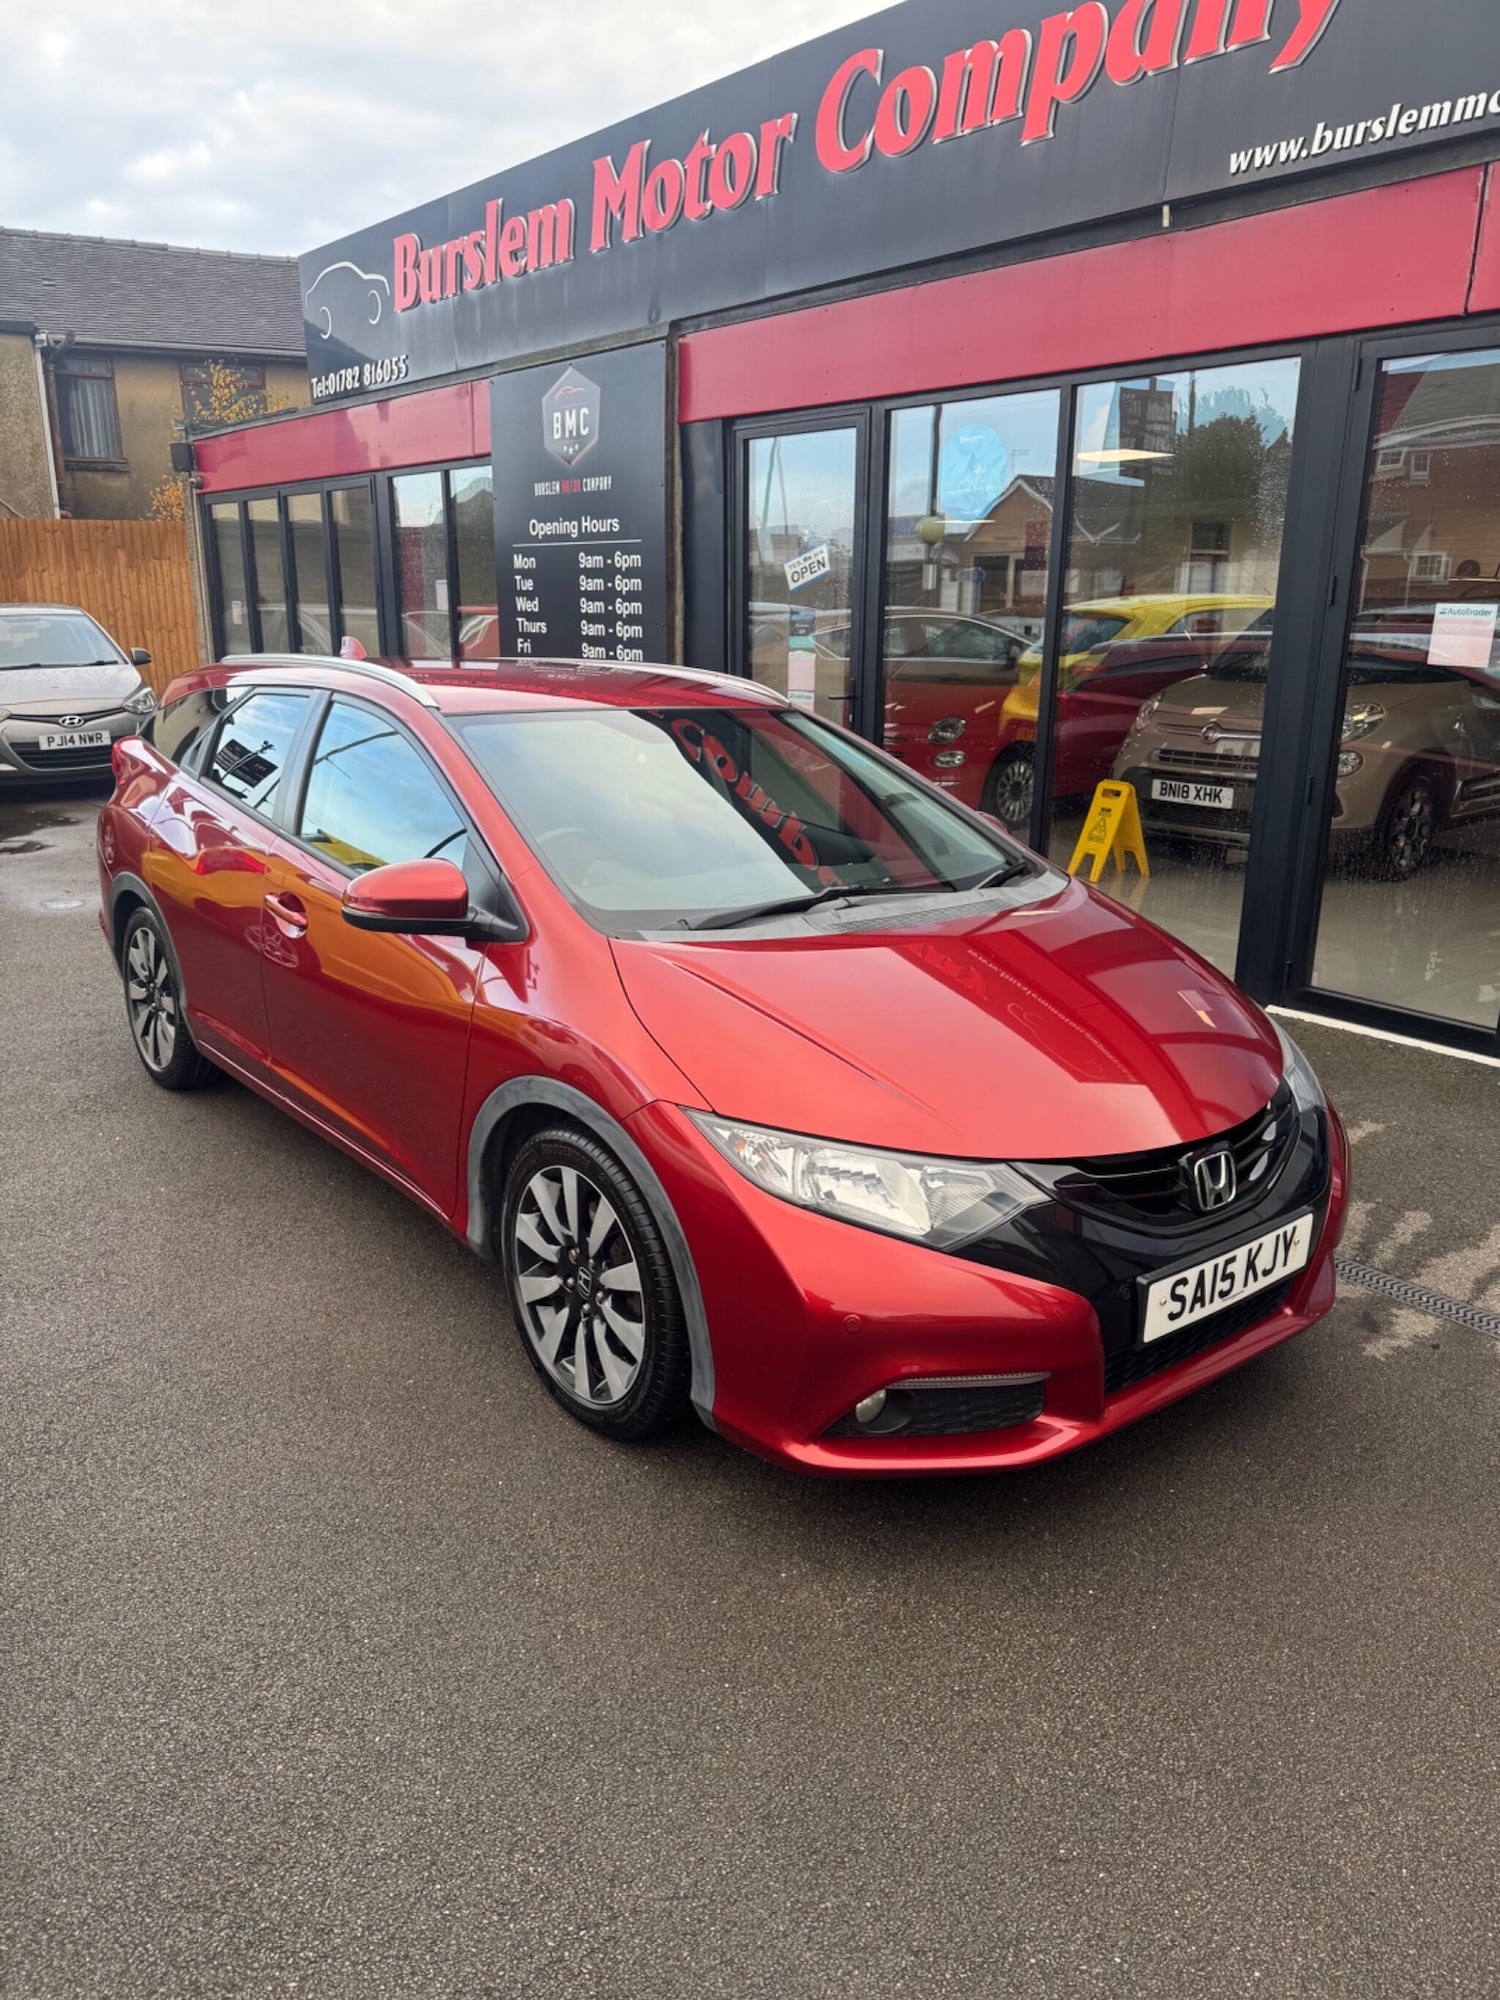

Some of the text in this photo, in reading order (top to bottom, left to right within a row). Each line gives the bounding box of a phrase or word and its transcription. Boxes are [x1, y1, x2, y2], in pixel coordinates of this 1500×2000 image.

[392, 197, 575, 313] Burslem
[589, 112, 798, 254] Motor
[310, 354, 408, 399] Tel:01782 816055
[553, 406, 589, 440] BMC
[529, 515, 620, 540] Opening Hours
[513, 553, 536, 570] Mon
[578, 552, 604, 569] 9am
[614, 551, 642, 572] 6pm
[791, 556, 826, 583] OPEN
[514, 575, 534, 591] Tue
[579, 575, 605, 592] 9am
[614, 574, 642, 595] 6pm
[515, 596, 539, 612] Wed
[580, 597, 605, 614] 9am
[615, 598, 643, 618] 6pm
[1447, 608, 1493, 617] AutoTrader
[516, 617, 547, 634] Thurs
[580, 619, 606, 636] 9am
[615, 621, 643, 641] 6pm
[517, 638, 532, 654] Fri
[581, 642, 607, 660] 9am
[616, 644, 643, 663] 6pm
[47, 732, 103, 748] PJ14 NWR
[1160, 781, 1223, 804] BN18 XHK
[1167, 1225, 1298, 1322] SA15 KJY
